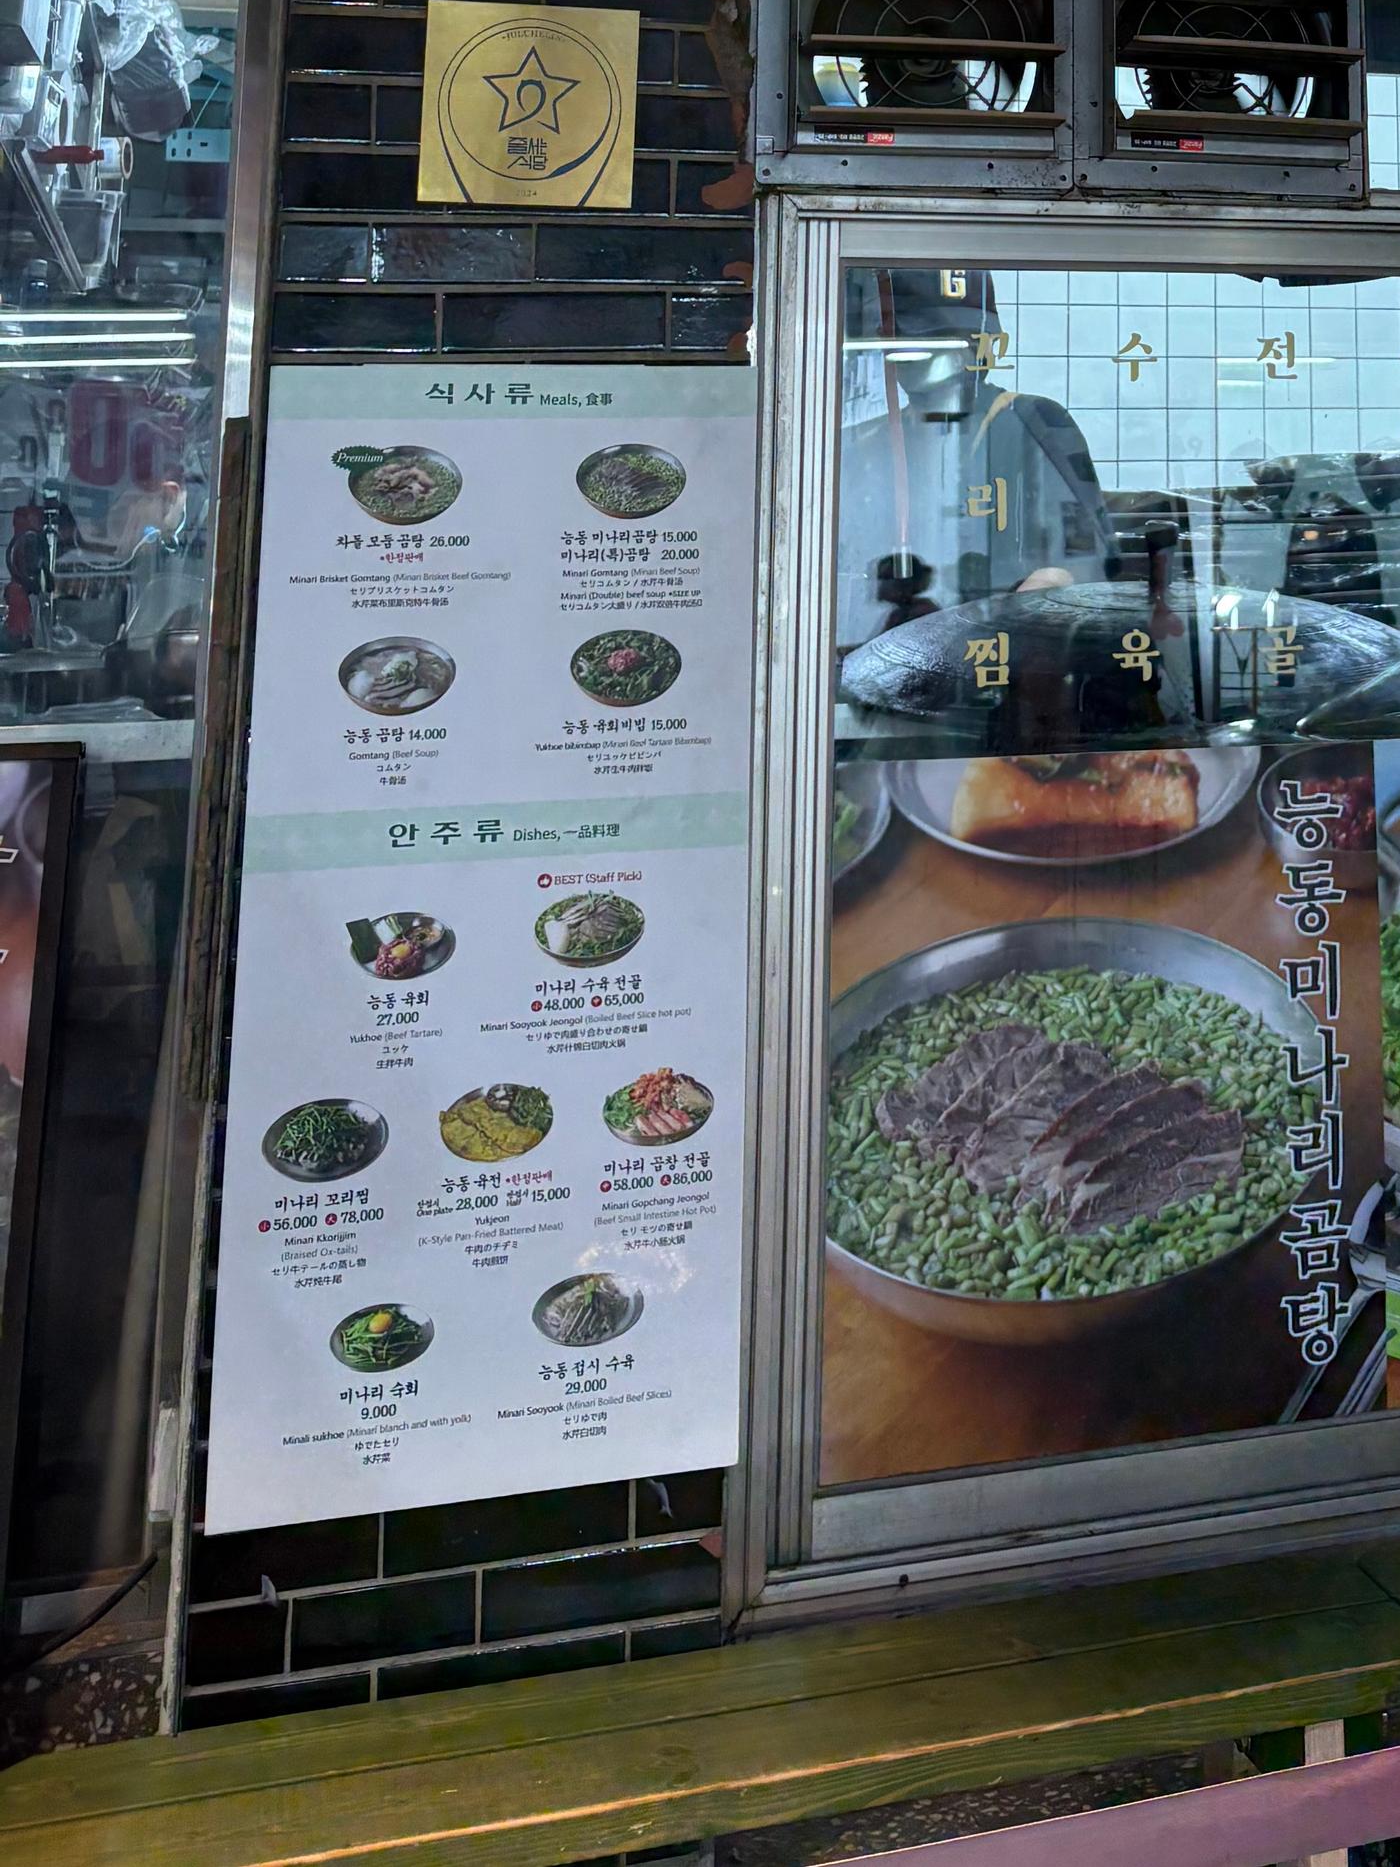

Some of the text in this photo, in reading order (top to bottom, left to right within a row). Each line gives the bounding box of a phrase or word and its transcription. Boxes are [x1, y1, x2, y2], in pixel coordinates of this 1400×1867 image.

[507, 155, 548, 170] 식당
[540, 394, 582, 408] Meals,
[585, 393, 613, 406] 食事
[337, 453, 383, 463] Premium
[336, 534, 363, 549] 차돌
[367, 534, 394, 548] 모둠
[397, 534, 424, 548] 곰탕
[561, 531, 588, 545] 능동
[320, 574, 348, 583] Brisket
[351, 574, 391, 583] Gomtang
[423, 573, 449, 581] Brisket
[451, 572, 470, 580] Beef
[562, 570, 589, 578] Minari
[591, 569, 628, 578] Gomtang
[561, 592, 587, 600] Minari
[626, 590, 645, 598] beef
[647, 591, 666, 599] soup
[562, 720, 589, 734] 능동
[343, 728, 372, 744] 능동
[376, 727, 405, 743] 곰탕
[349, 749, 439, 761] Gomtang (Beef Soup)
[376, 763, 412, 772] コムタン
[513, 829, 561, 842] Dishes,
[563, 824, 620, 839] 一品料理
[554, 871, 642, 885] BEST (Staff Pick)
[535, 974, 642, 996] 미나리 수육 전골
[367, 990, 429, 1011] 능동 육회
[481, 1024, 508, 1032] Minari
[510, 1019, 547, 1030] Sooyook
[549, 1016, 583, 1028] Jeongol
[658, 1009, 673, 1018] hot
[350, 1028, 442, 1044] Yukhoe (Beef Tartare)
[383, 1045, 409, 1054] ユッケ
[1272, 777, 1351, 1366] 능동미나리곰탕
[604, 1157, 645, 1176] 미나리
[682, 1151, 711, 1168] 전골
[441, 1175, 469, 1194] 능동
[474, 1173, 501, 1189] 육전
[275, 1188, 369, 1213] 미나리 꼬리찜
[602, 1192, 709, 1211] Minari Gopchang Jeongol
[475, 1214, 510, 1226] Yukjeon
[618, 1213, 642, 1223] Small
[644, 1209, 680, 1220] Intestine
[682, 1207, 697, 1216] Hot
[499, 1226, 536, 1237] Battered
[285, 1236, 314, 1247] Minari
[281, 1249, 318, 1262] (Braised
[538, 1354, 635, 1381] 능동 접시 수육
[340, 1380, 419, 1404] 미나리 숙회
[498, 1409, 525, 1420] Minari
[527, 1403, 564, 1416] Sooyook
[380, 1422, 409, 1434] blanch
[411, 1419, 428, 1430] and
[430, 1417, 449, 1427] with
[355, 1436, 400, 1451] ゆでたセリ
